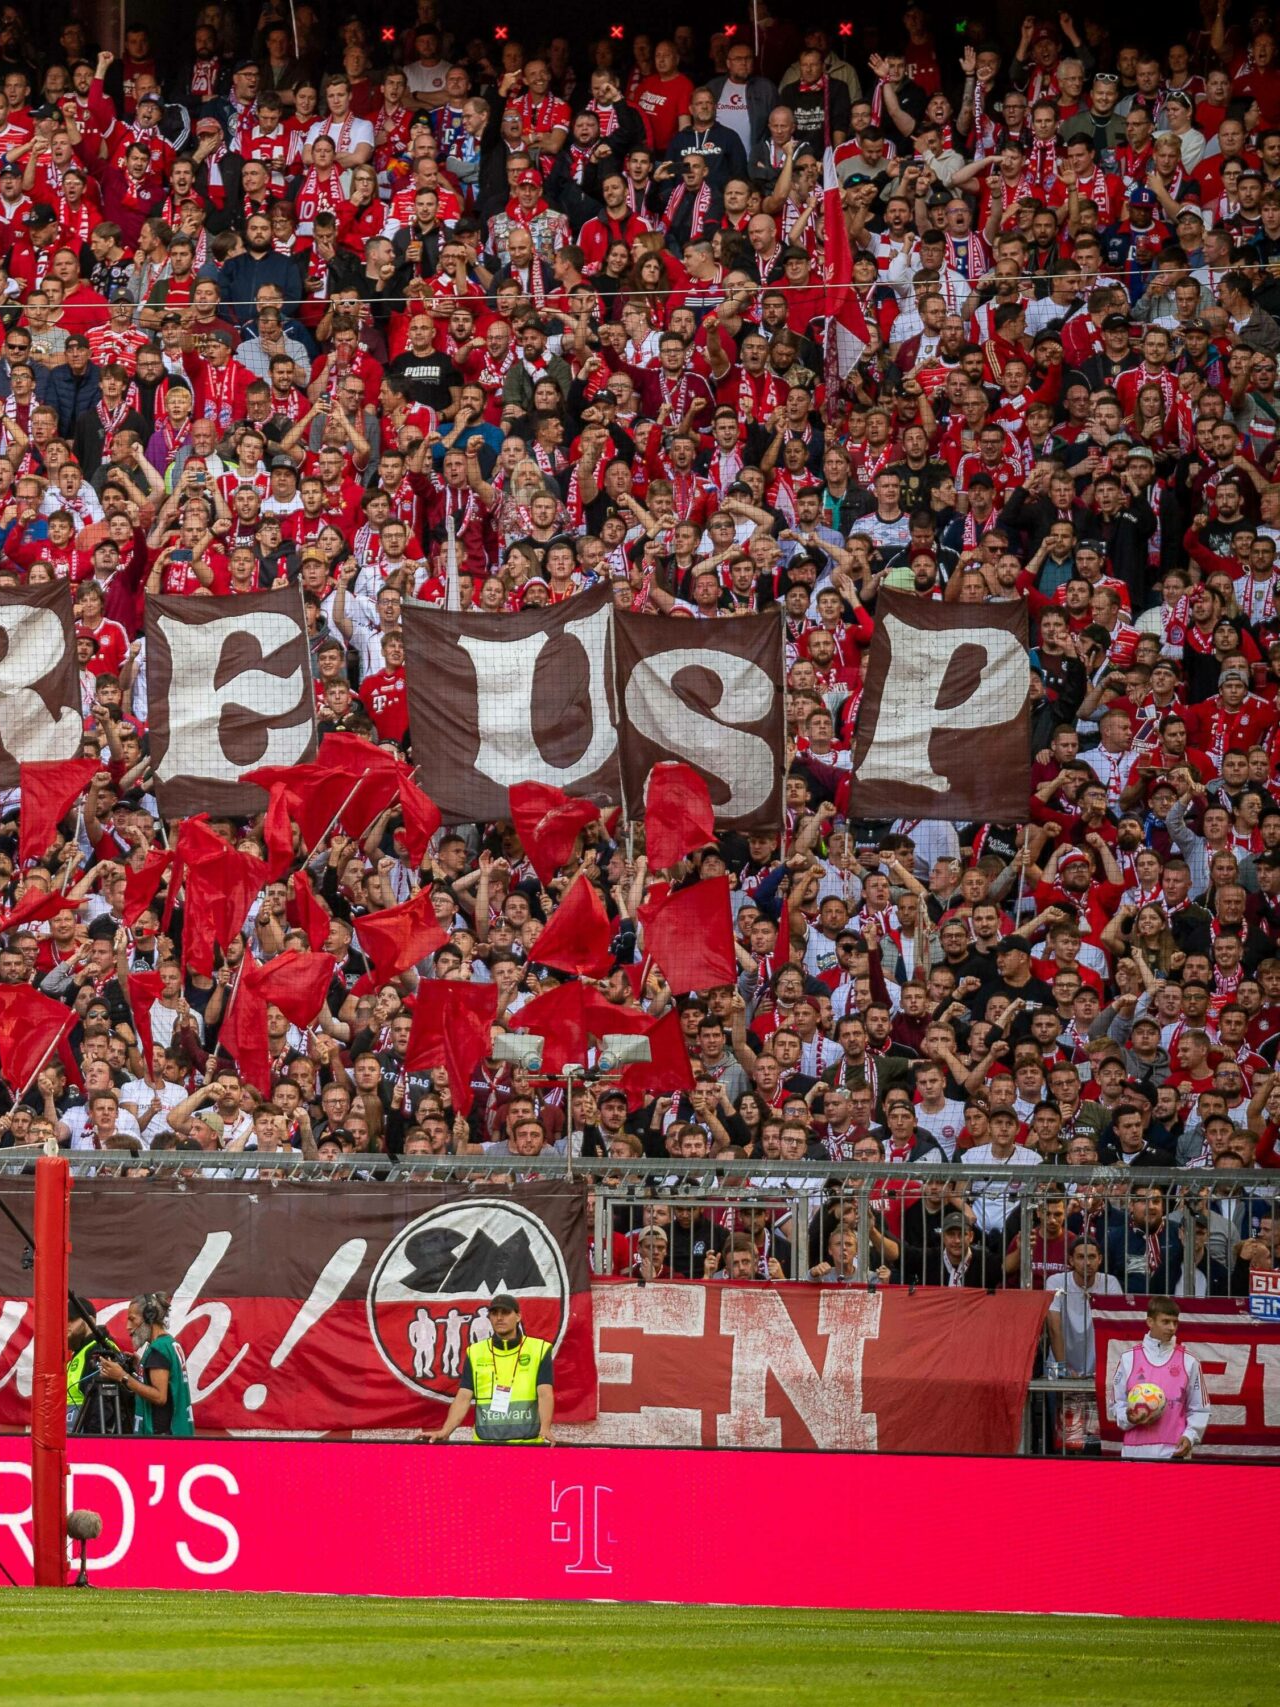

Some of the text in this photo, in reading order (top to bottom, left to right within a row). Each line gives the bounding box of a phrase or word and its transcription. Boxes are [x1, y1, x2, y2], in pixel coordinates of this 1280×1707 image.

[680, 146, 722, 156] ellesse
[299, 200, 314, 219] 10
[404, 366, 441, 377] PUMA
